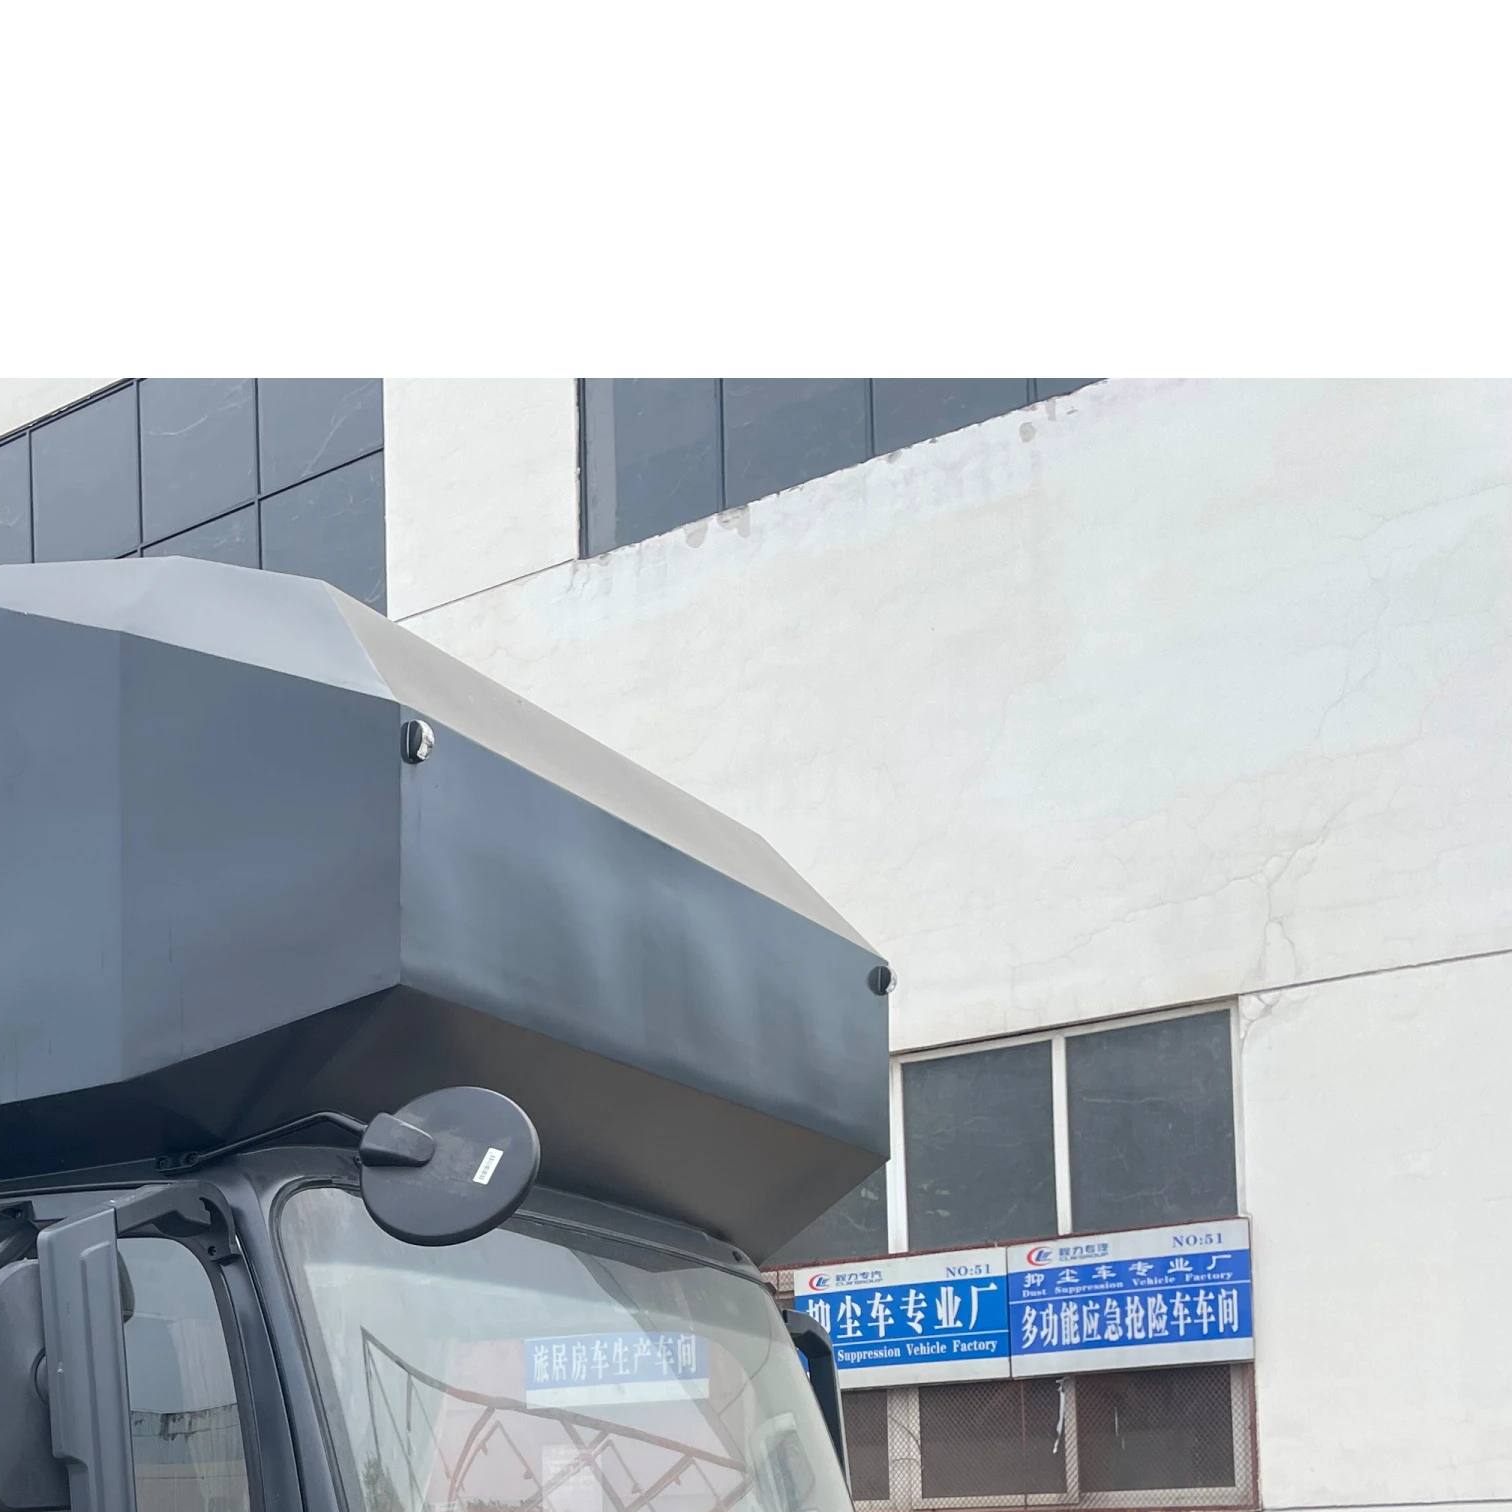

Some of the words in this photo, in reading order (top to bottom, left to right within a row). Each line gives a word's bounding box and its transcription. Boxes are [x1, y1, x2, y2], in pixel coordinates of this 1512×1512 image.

[1172, 1233, 1223, 1248] NO:51
[946, 1264, 991, 1278] NO:51
[1022, 1288, 1047, 1298] Dust
[1055, 1281, 1124, 1294] Suppression
[1132, 1275, 1176, 1287] Vehicle
[1185, 1271, 1233, 1282] Factory
[1024, 1254, 1232, 1288] 抑尘车专业厂
[1021, 1287, 1240, 1350] 多功能应急抢险车车间
[533, 1334, 697, 1383] 旅居房车生产车间
[838, 1345, 901, 1363] Suppression
[906, 1342, 947, 1356] Vehicle
[952, 1339, 998, 1355] Factory
